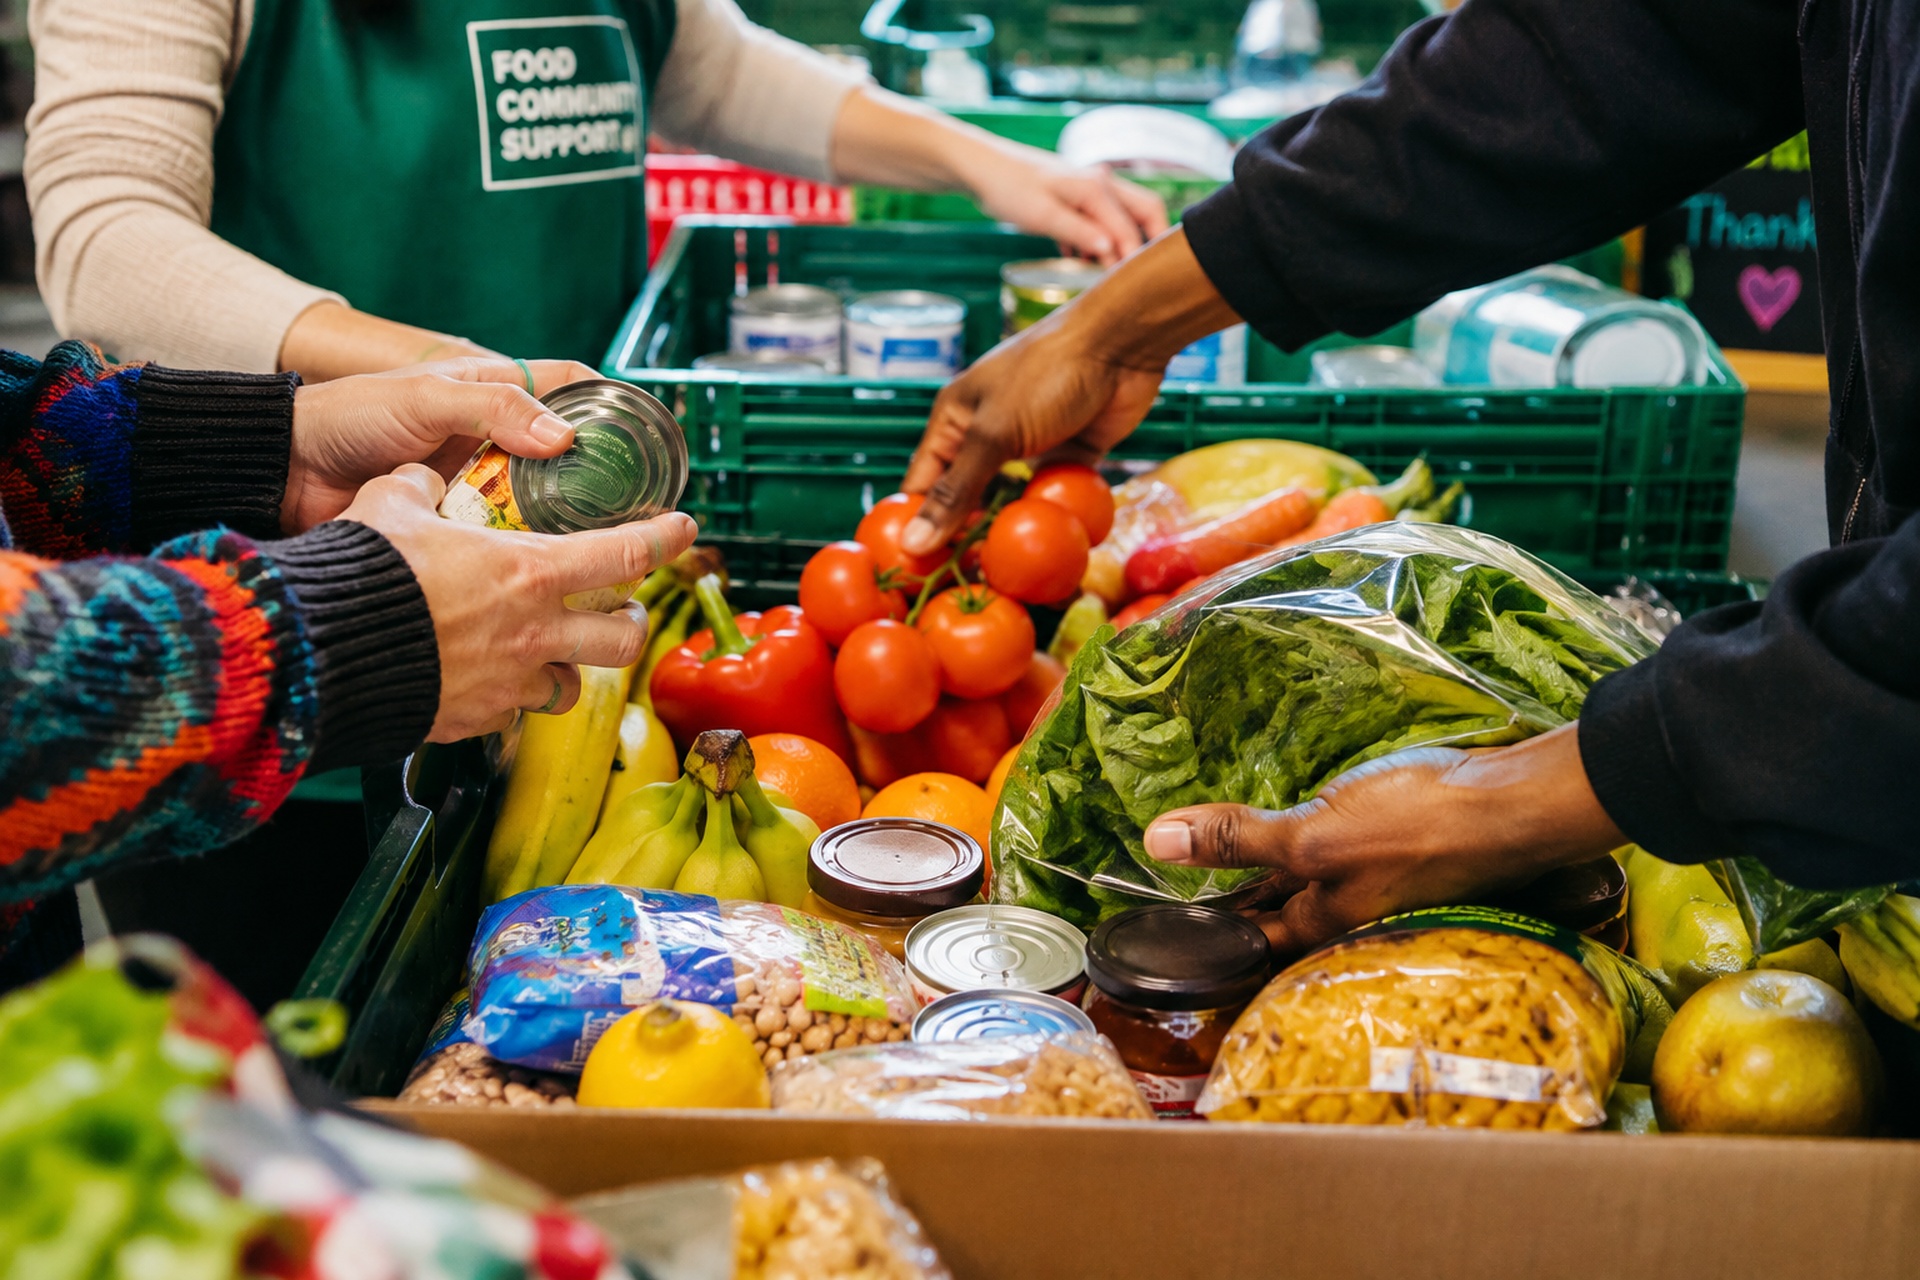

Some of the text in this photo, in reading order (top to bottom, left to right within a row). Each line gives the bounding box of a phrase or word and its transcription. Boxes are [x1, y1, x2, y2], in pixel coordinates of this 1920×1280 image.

[491, 47, 576, 83] FOOD
[501, 120, 620, 161] SUPPORT
[1680, 193, 1817, 250] Thank
